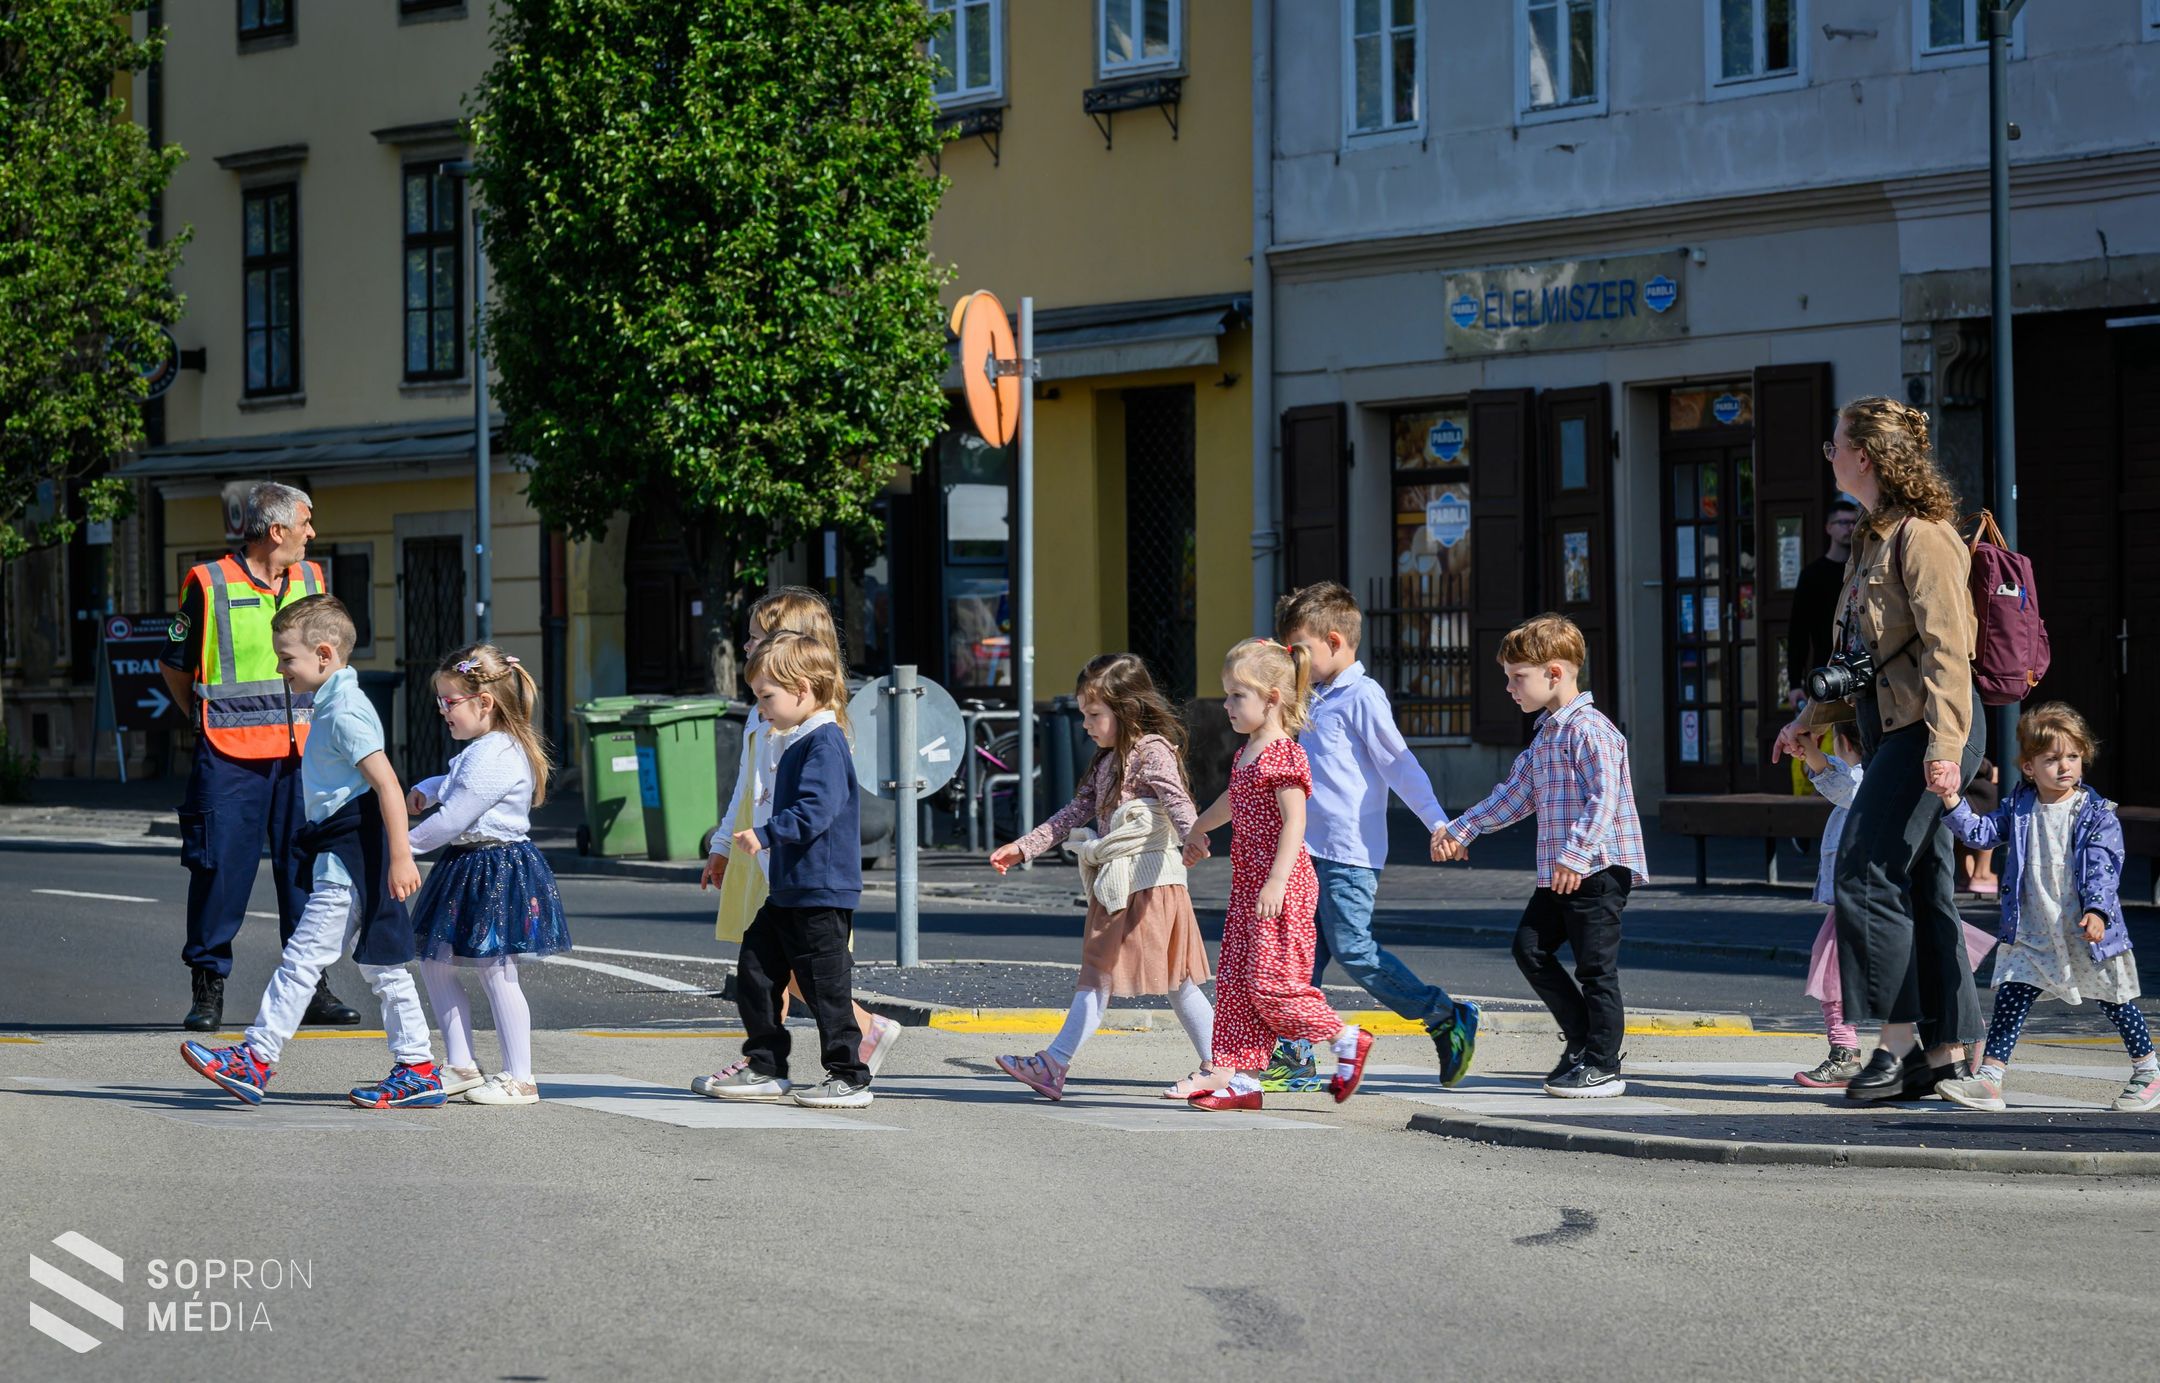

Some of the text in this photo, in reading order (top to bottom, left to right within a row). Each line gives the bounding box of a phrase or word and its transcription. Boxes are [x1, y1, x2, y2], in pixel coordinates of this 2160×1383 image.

[1484, 279, 1636, 329] ÉLELMISZER
[1432, 430, 1461, 444] PAROLA
[1430, 507, 1467, 524] PAROLA
